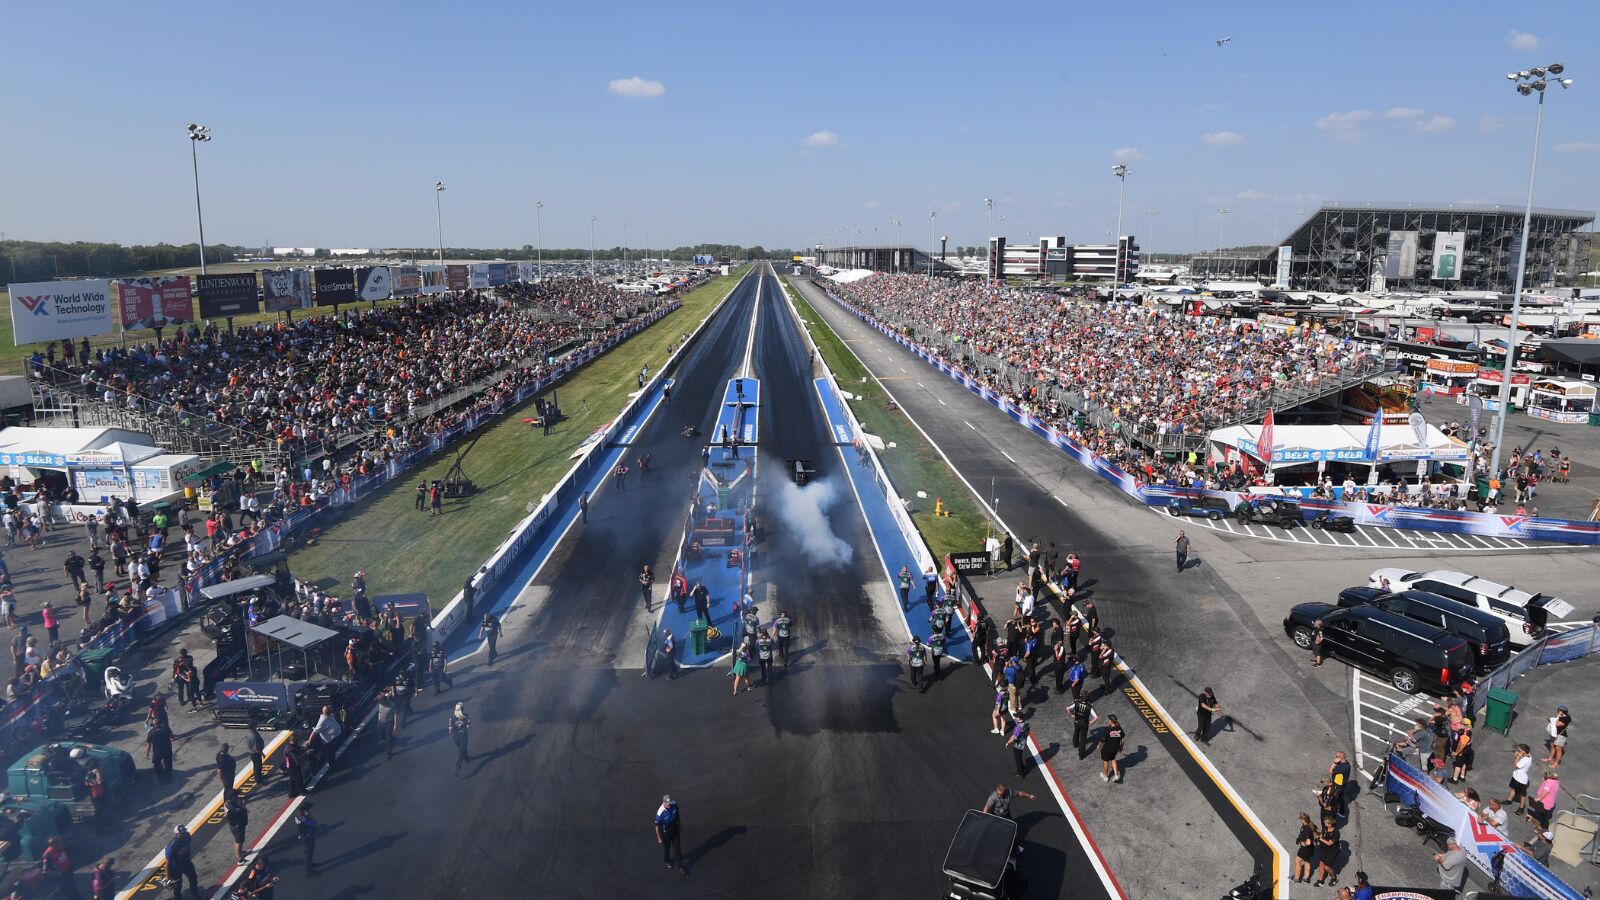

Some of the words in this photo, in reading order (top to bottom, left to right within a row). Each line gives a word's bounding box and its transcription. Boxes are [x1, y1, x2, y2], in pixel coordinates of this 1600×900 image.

[200, 276, 254, 288] LINDENWOOD
[53, 293, 81, 304] World
[82, 292, 105, 302] Wide
[54, 303, 105, 315] Technology
[27, 455, 52, 464] BEER
[1284, 451, 1309, 459] BEER
[1337, 450, 1363, 459] BEER
[96, 478, 116, 486] Coors
[494, 542, 522, 580] MIDWEST
[522, 507, 549, 546] NATIONALS
[1123, 687, 1169, 733] RESTRICTED
[1376, 891, 1430, 900] CHAMPIONSHIP
